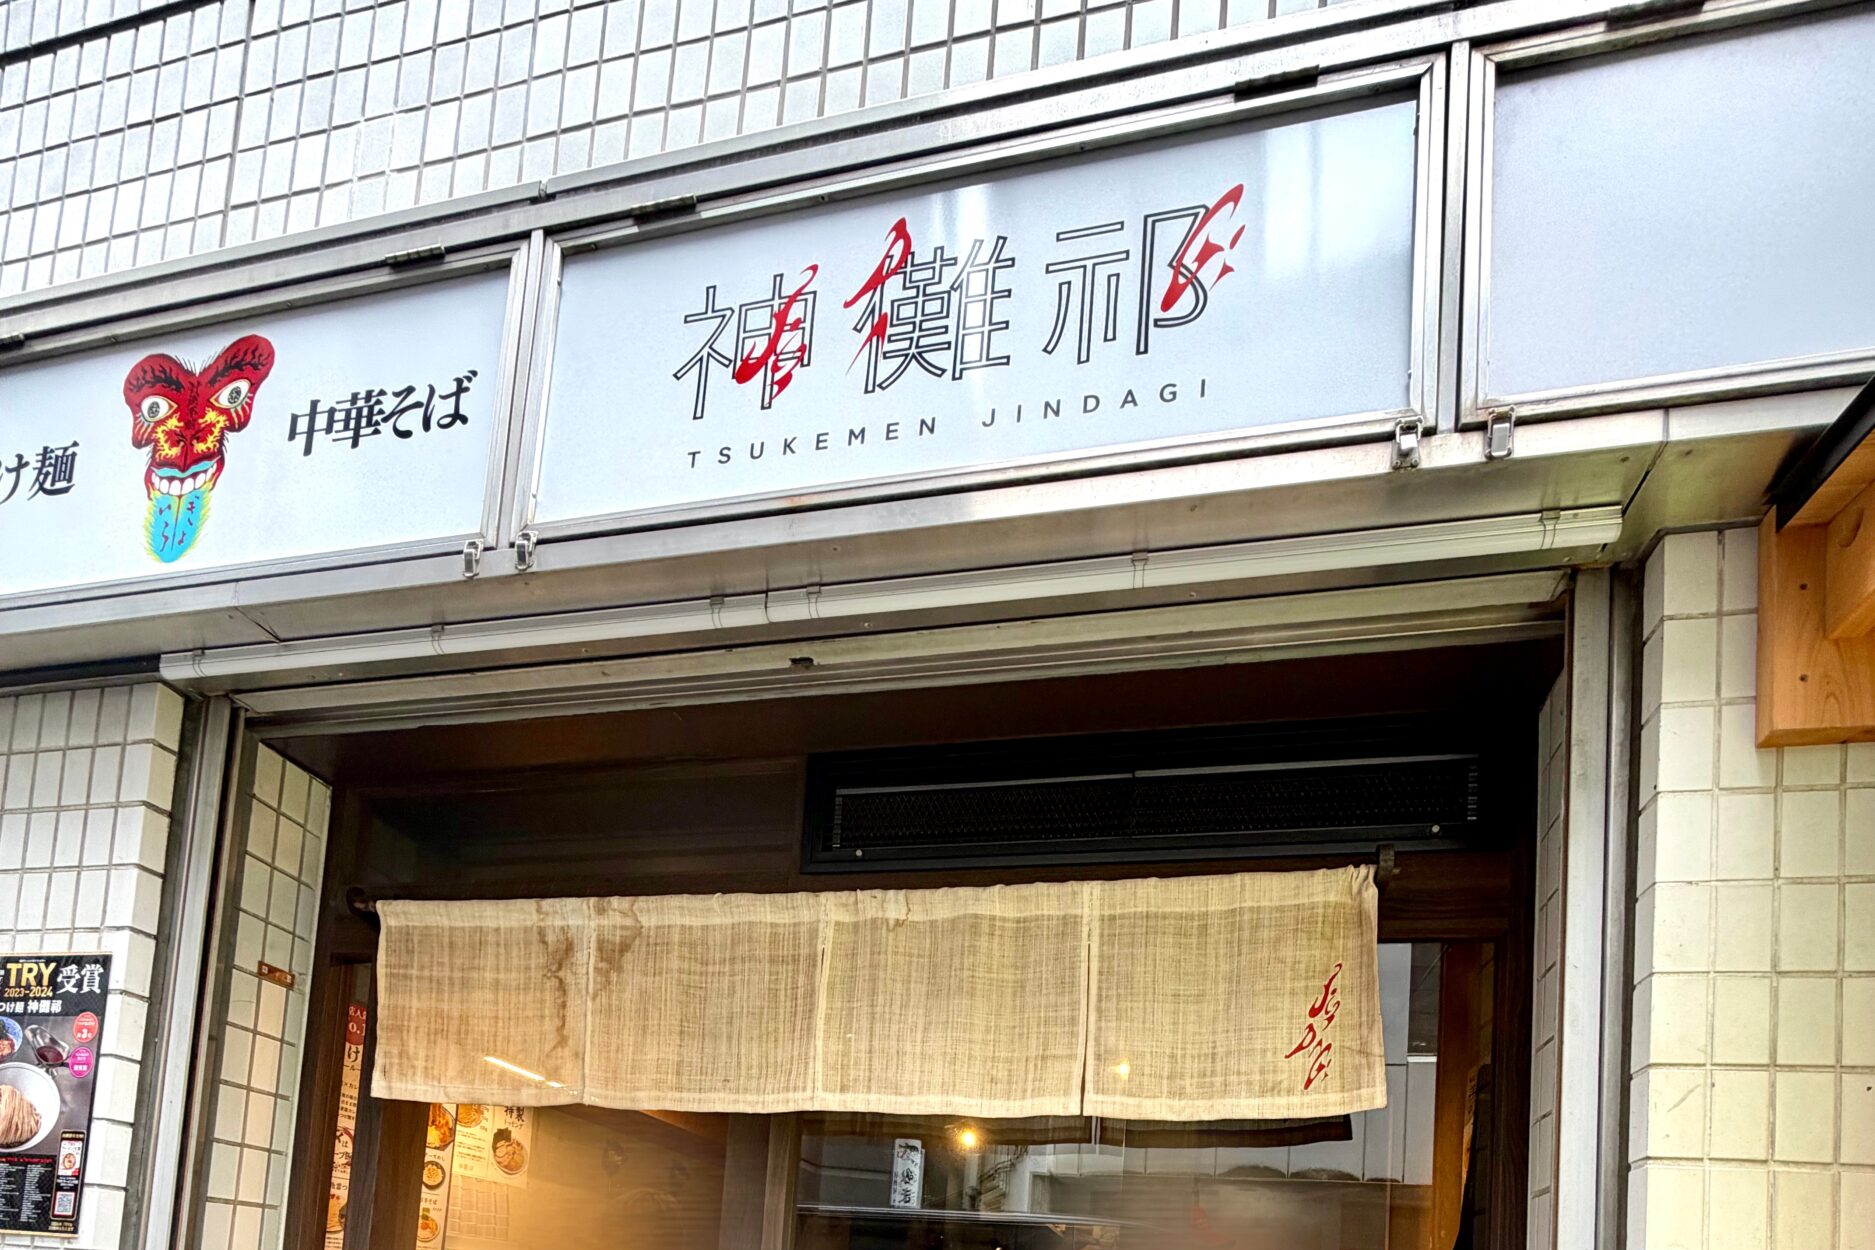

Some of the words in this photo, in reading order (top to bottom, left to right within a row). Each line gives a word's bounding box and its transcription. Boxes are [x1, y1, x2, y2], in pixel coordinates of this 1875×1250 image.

[287, 369, 478, 456] 中華そば
[687, 416, 937, 468] TSUKEMEN
[981, 378, 1208, 428] JINDAGI
[4, 986, 54, 997] 2023-2024
[6, 962, 57, 987] TRY
[56, 963, 104, 994] 受賞
